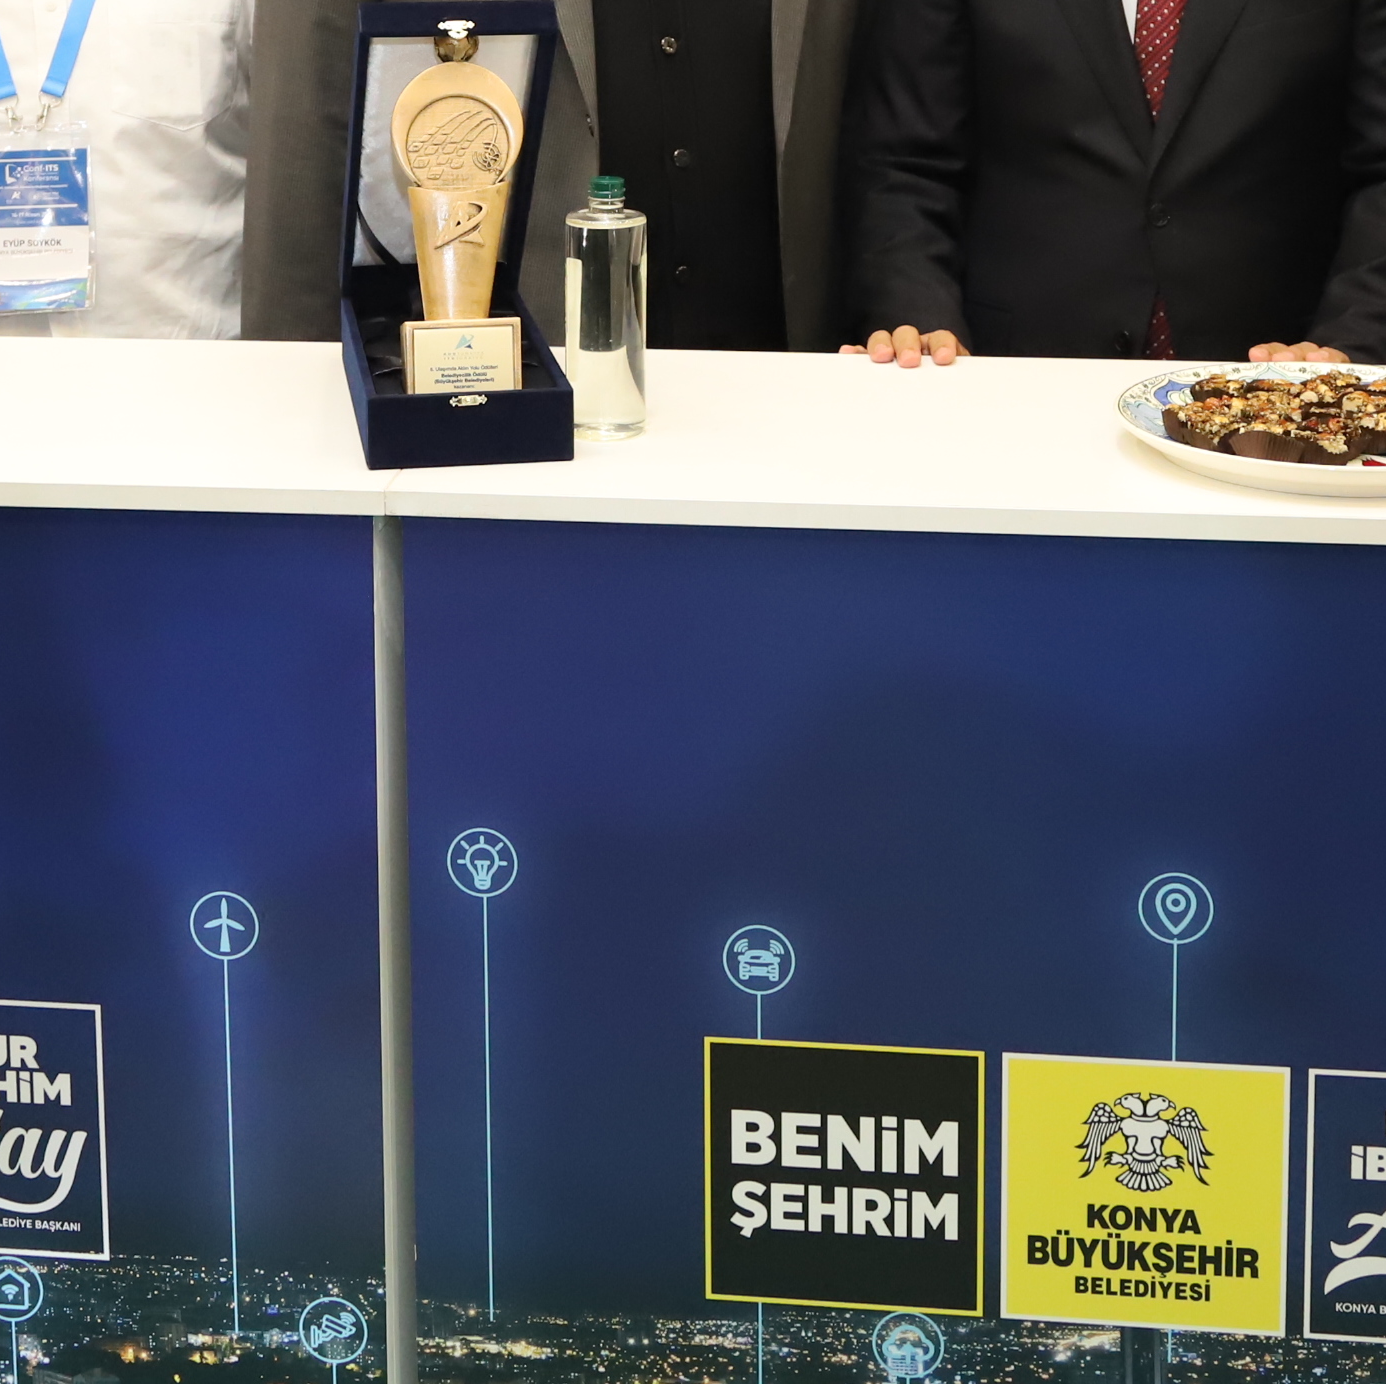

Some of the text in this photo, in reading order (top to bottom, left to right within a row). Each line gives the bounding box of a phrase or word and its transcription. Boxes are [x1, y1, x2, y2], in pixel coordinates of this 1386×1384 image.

[3, 239, 25, 248] EYÜP
[35, 1219, 81, 1233] BAŞKANI
[1086, 1203, 1202, 1235] KONYA
[1027, 1229, 1260, 1279] BÜYÜKŞEHİR
[1074, 1275, 1211, 1302] BELEDİYESİ
[1335, 1302, 1377, 1315] KONYA
